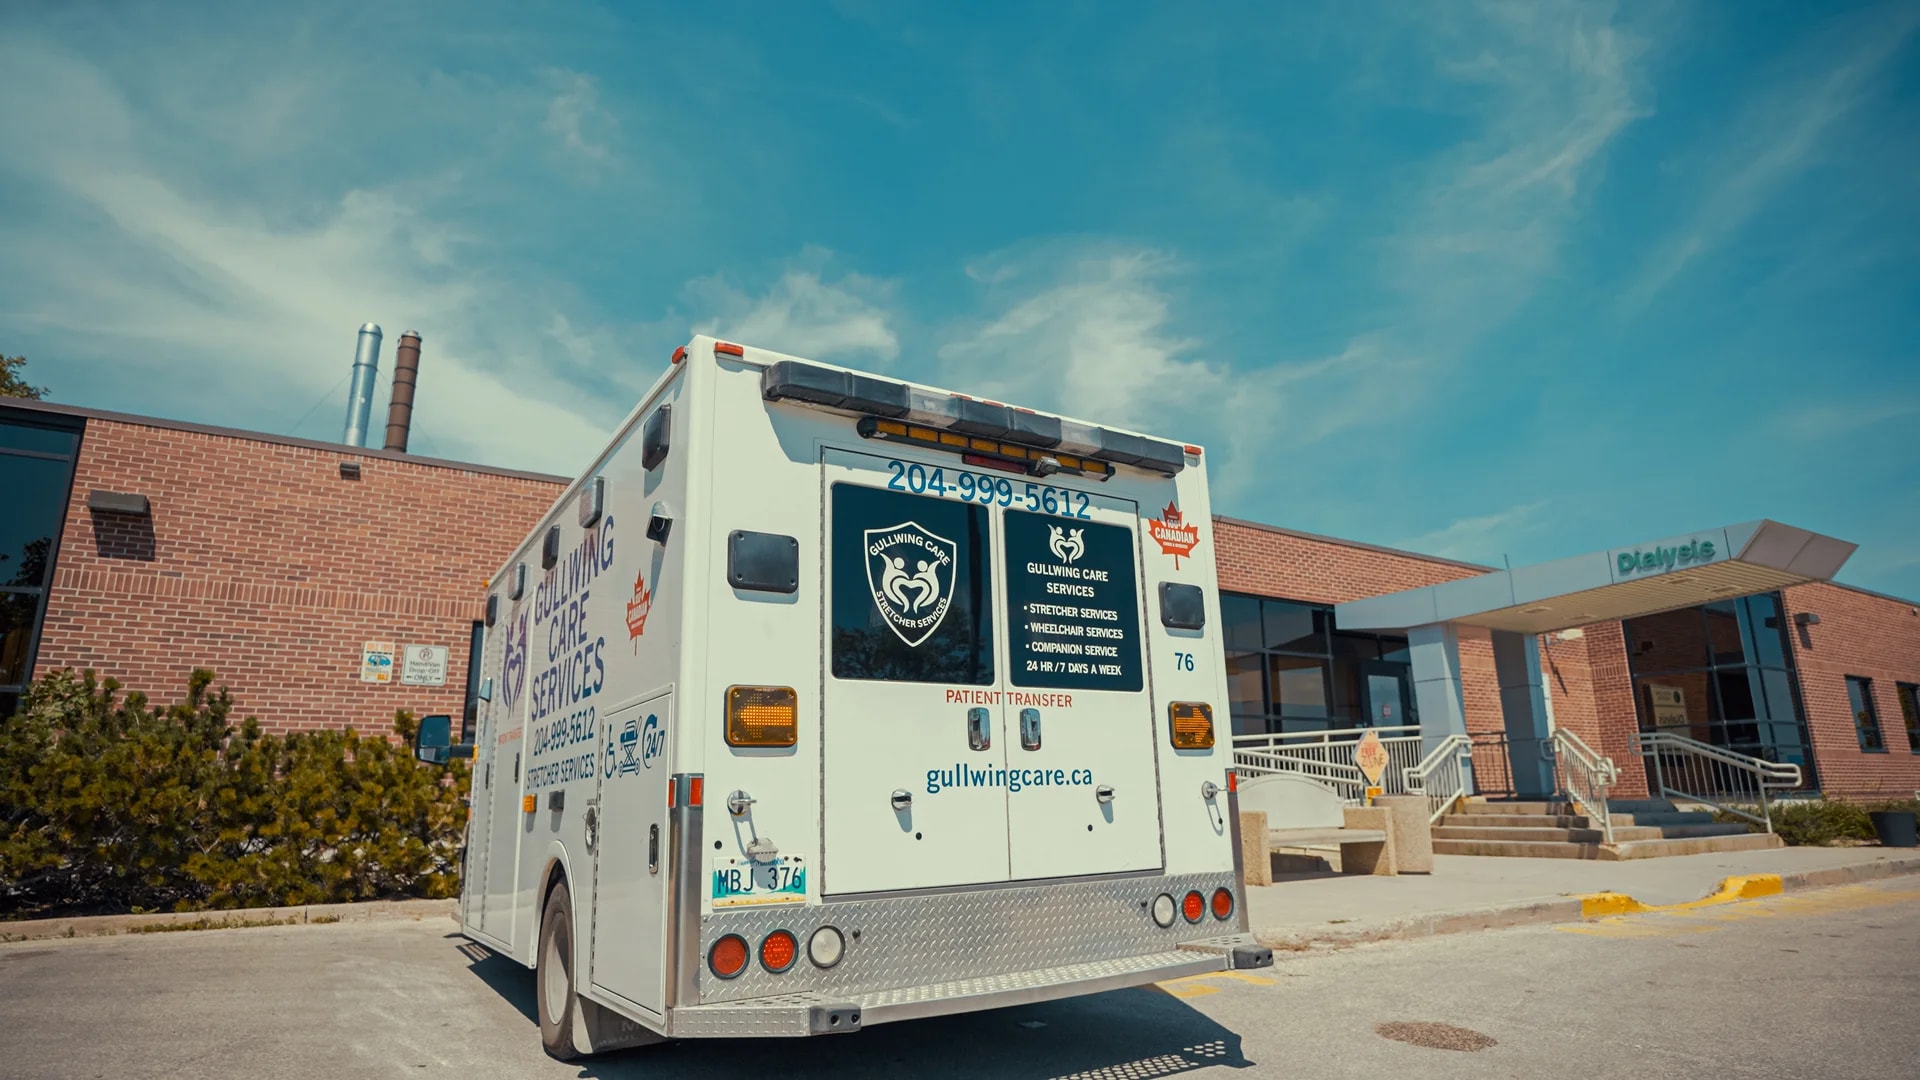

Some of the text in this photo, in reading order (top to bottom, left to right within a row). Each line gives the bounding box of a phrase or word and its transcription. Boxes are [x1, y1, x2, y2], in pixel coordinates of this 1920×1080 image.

[887, 460, 1091, 520] 204-999-5612
[869, 533, 951, 566] GULLWING CARE
[1154, 527, 1195, 544] CANADIAN
[1617, 538, 1716, 572] Dialysis
[535, 515, 615, 626] GULLWING
[1027, 562, 1109, 582] GULLWING CARE
[1046, 582, 1095, 598] SERVICES
[876, 590, 947, 628] STRETCHER SERVICES
[1029, 603, 1118, 621] STRETCHER SERVICES
[548, 590, 590, 663] CARE
[1030, 622, 1124, 640] WHEELCHAIR SERVICES
[1031, 641, 1118, 657] COMPANION SERVICE
[1174, 652, 1194, 672] 76
[531, 636, 605, 722] SERVICES
[1026, 660, 1038, 671] 24
[1040, 661, 1053, 672] HR
[1068, 663, 1088, 674] DAYS
[1091, 664, 1097, 674] A
[1099, 664, 1122, 676] WEEK
[946, 689, 1073, 707] PATIENT TRANSFER
[533, 705, 595, 757] 204-999-5612
[645, 729, 666, 759] 24/7
[527, 753, 595, 790] STRETCHER SERVICES
[926, 763, 1093, 794] gullwingcare.ca
[717, 866, 802, 894] MBJ 376
